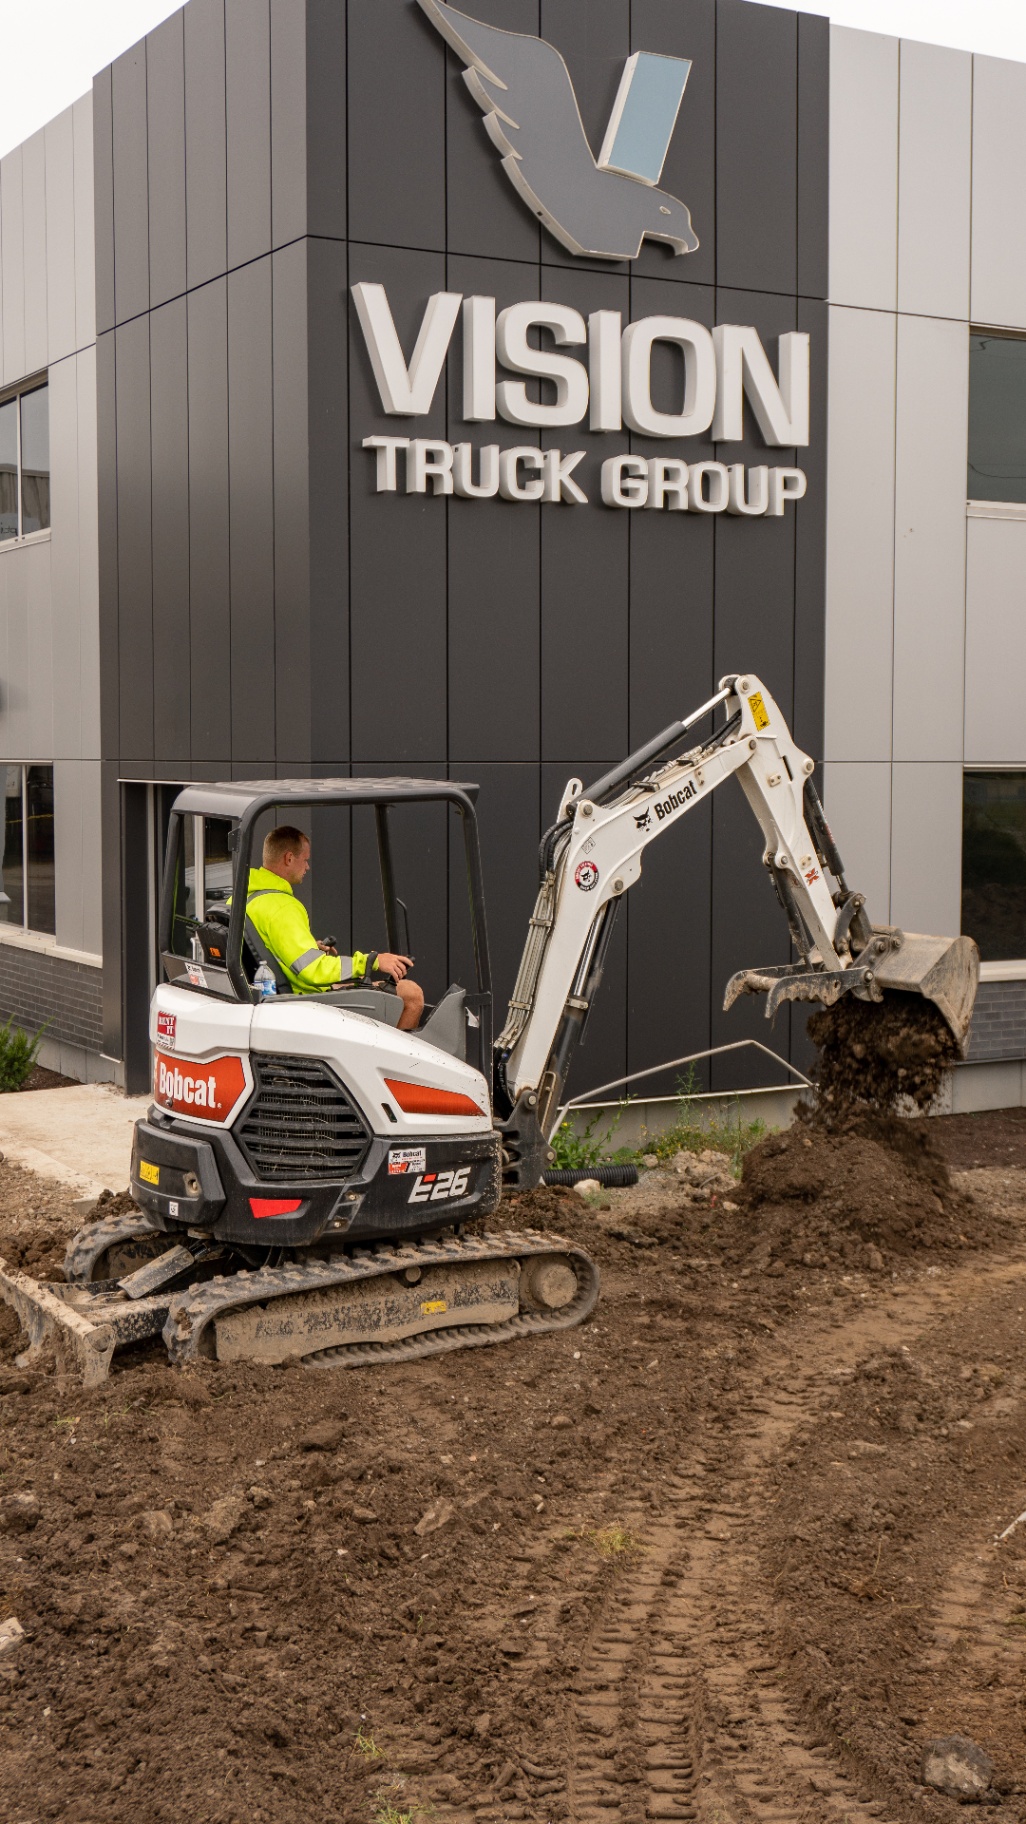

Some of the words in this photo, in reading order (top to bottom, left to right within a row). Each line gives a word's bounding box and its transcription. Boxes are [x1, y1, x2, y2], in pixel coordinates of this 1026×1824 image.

[351, 282, 810, 446] VISION
[362, 435, 588, 504] TRUCK
[601, 454, 807, 516] GROUP
[654, 780, 697, 821] Bobcat
[159, 1062, 216, 1108] Bobcat
[407, 1167, 471, 1203] E26
